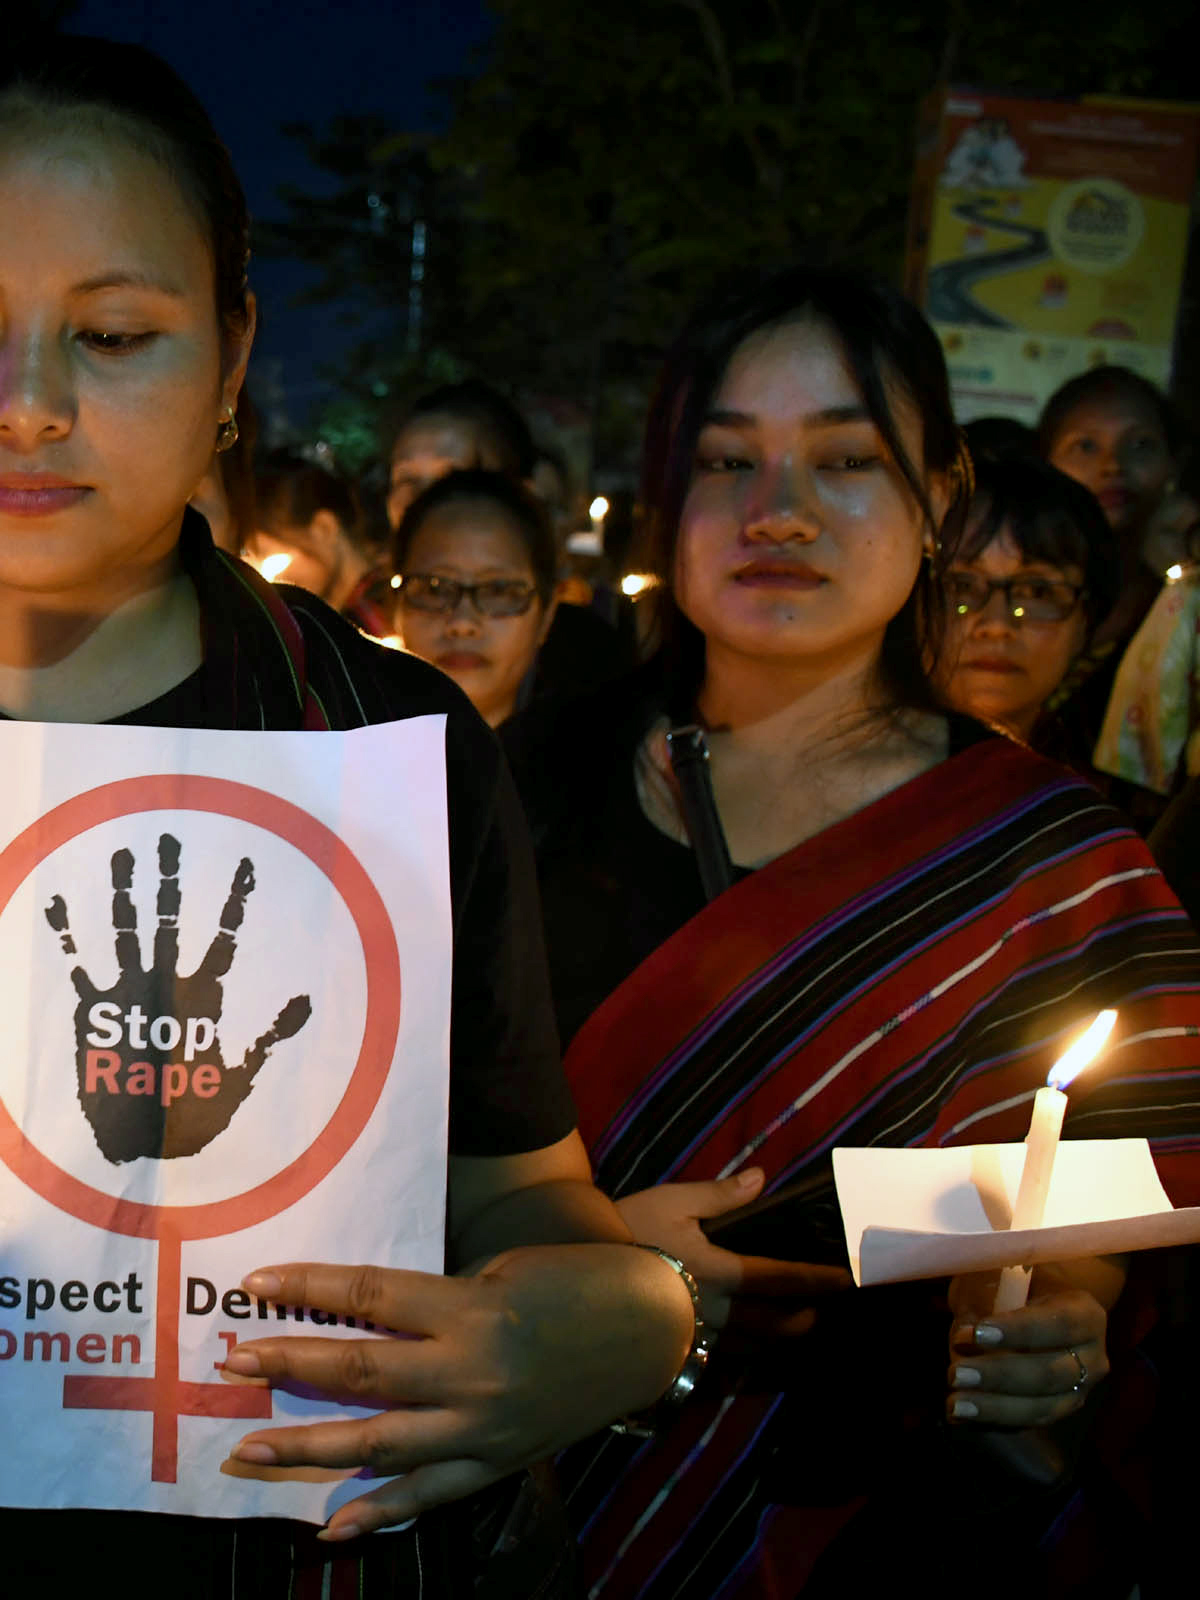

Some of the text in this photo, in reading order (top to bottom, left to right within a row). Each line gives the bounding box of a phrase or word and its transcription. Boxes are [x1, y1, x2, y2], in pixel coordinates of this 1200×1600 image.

[85, 1001, 217, 1062] Stop
[84, 1049, 222, 1107] Rape
[186, 1277, 402, 1333] Dema
